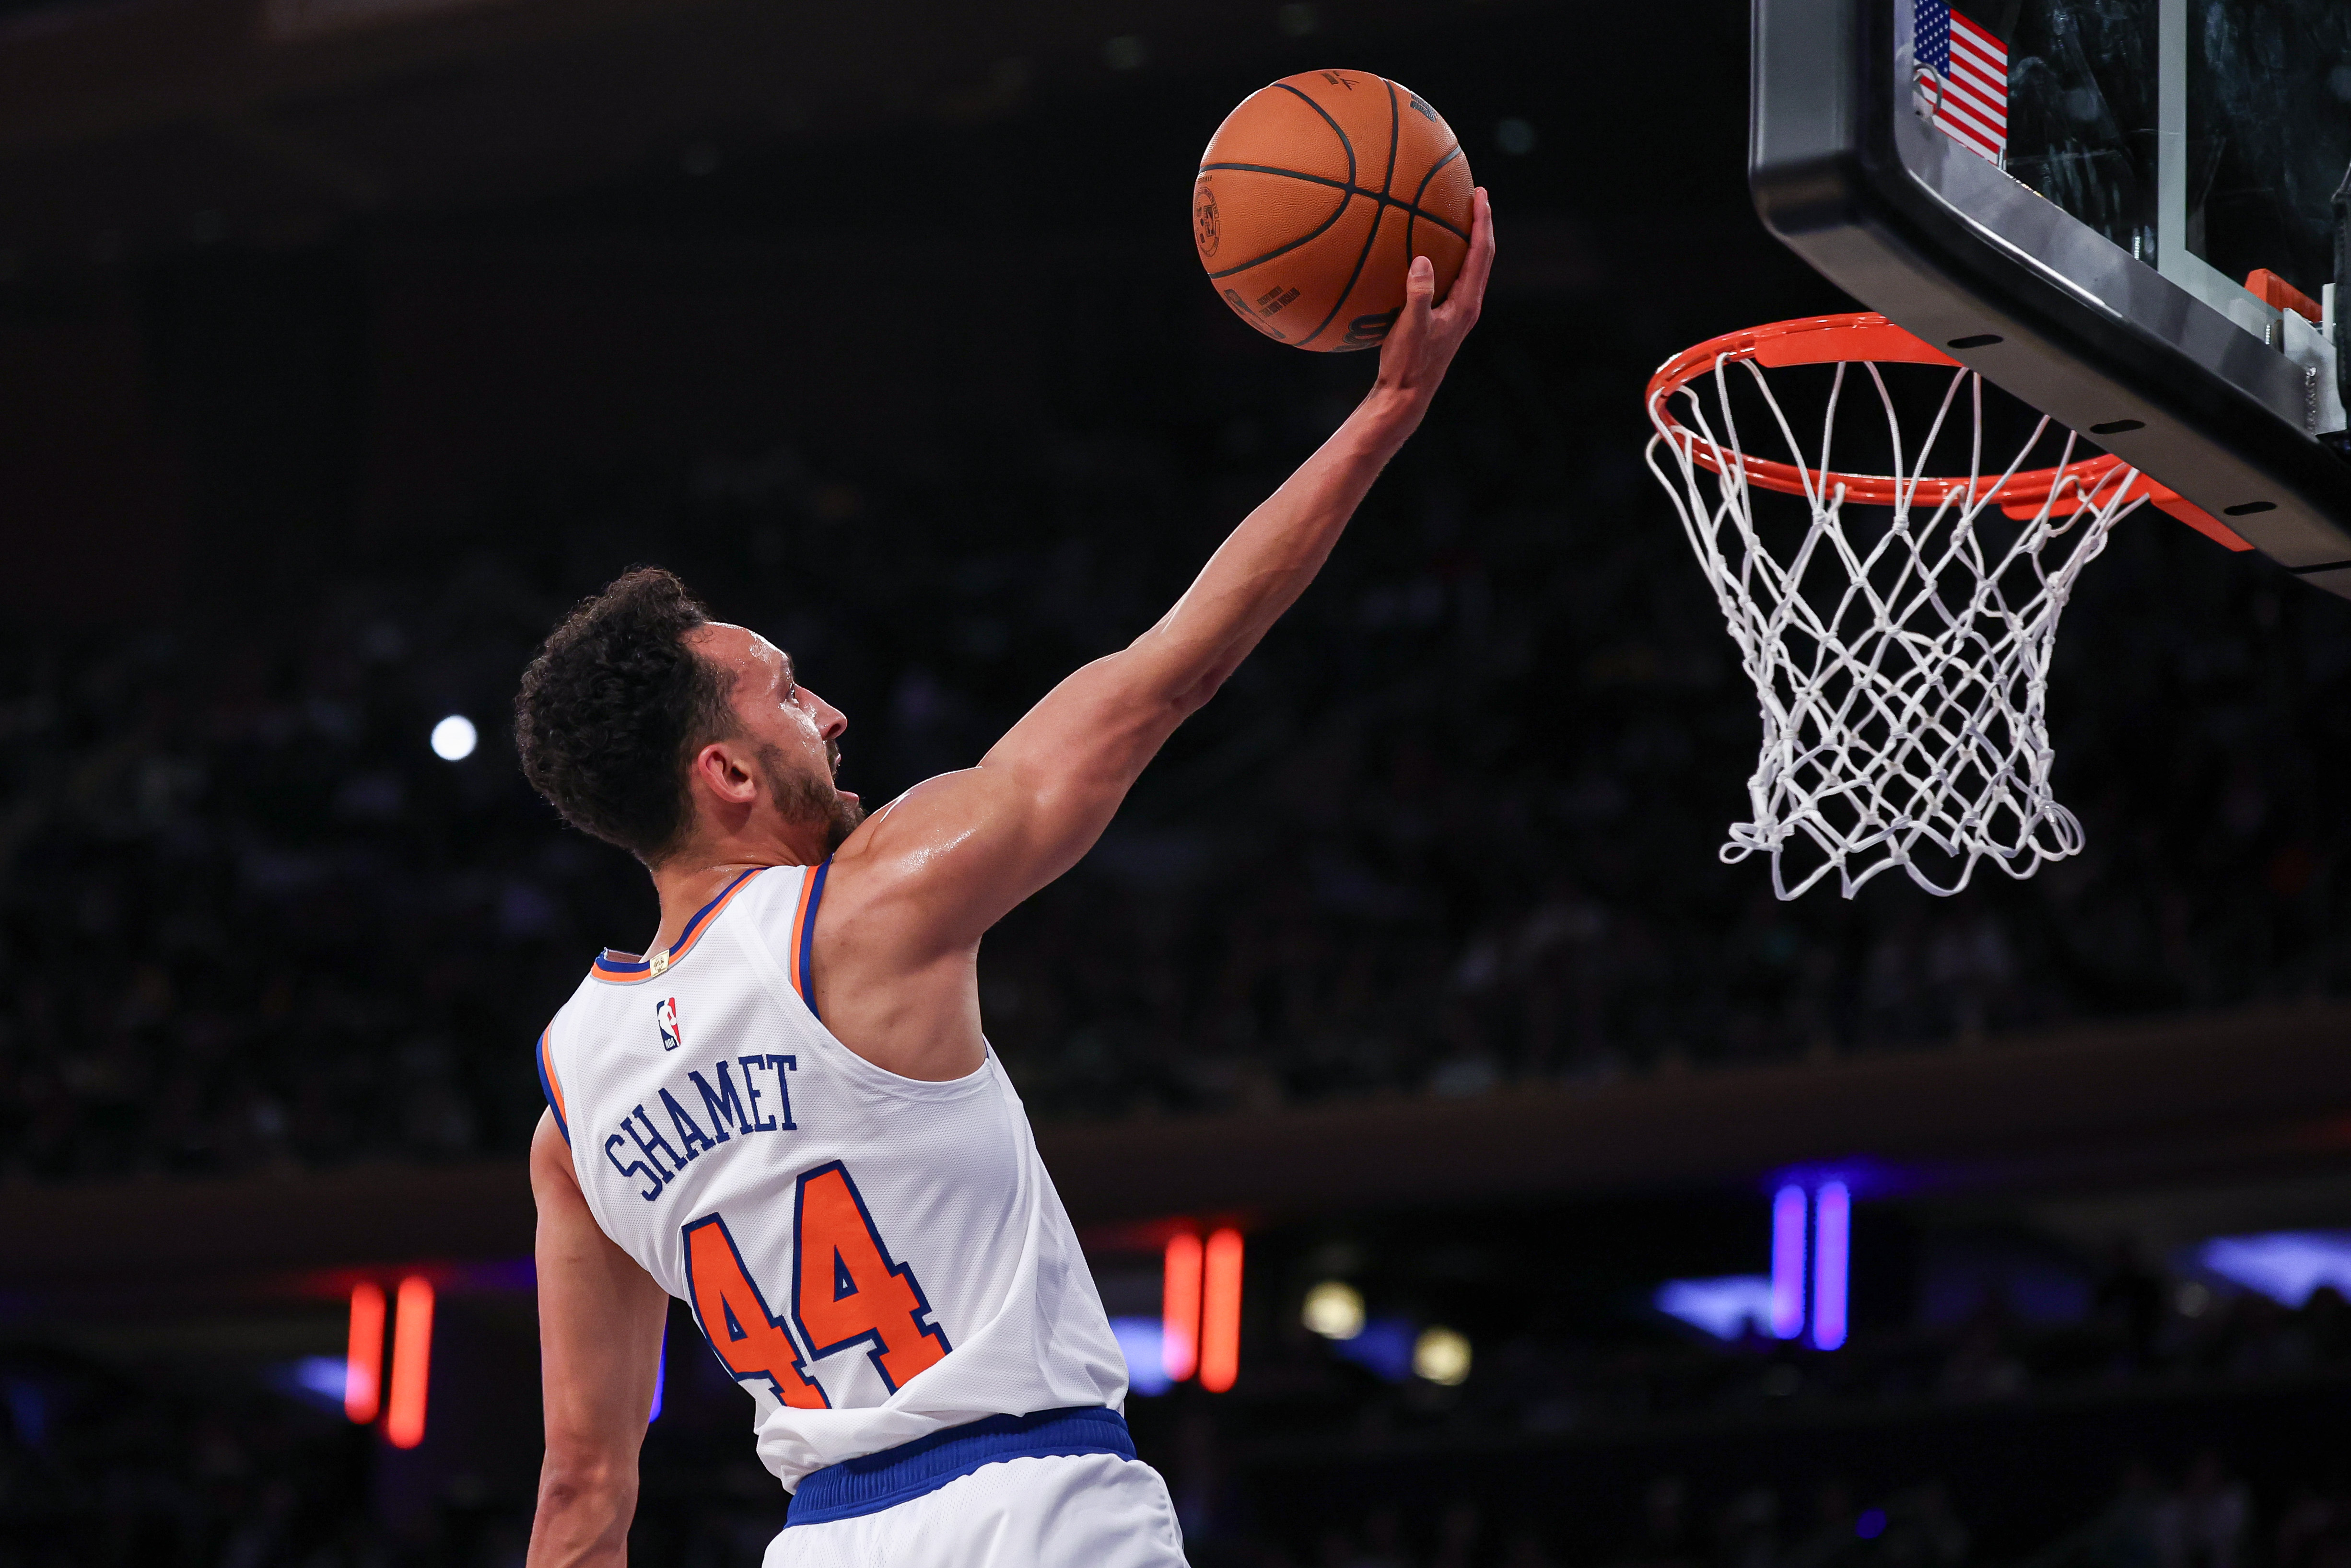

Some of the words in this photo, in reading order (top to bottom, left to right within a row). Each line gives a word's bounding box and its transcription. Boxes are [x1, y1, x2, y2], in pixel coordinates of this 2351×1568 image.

[665, 1037, 675, 1049] NBA
[605, 1055, 797, 1201] SHAMET
[682, 1159, 953, 1410] 44
